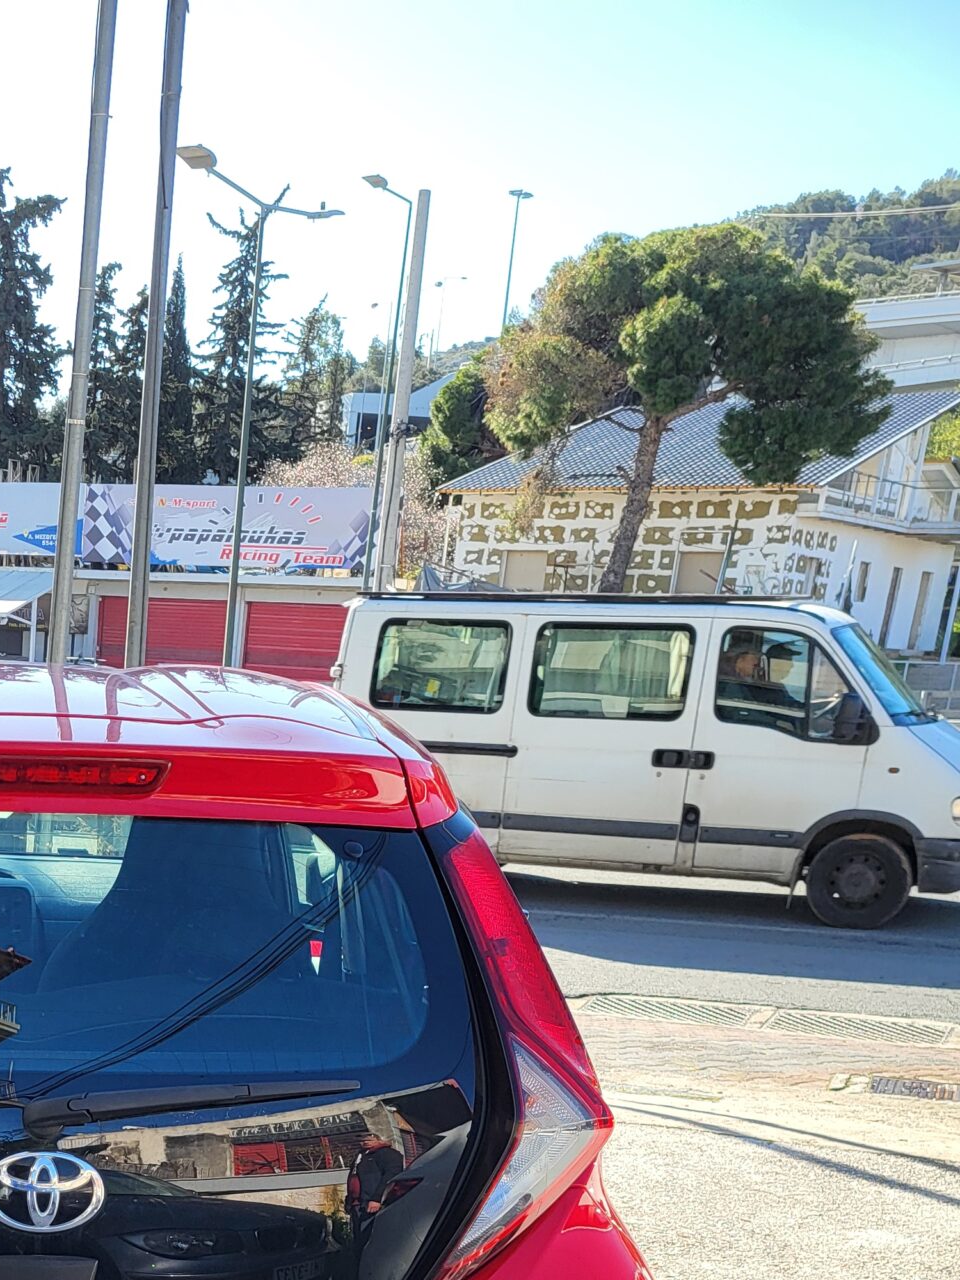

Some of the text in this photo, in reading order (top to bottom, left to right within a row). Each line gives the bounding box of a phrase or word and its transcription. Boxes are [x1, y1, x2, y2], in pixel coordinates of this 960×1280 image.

[172, 498, 216, 509] M-sport
[219, 547, 345, 566] Rcing Team
